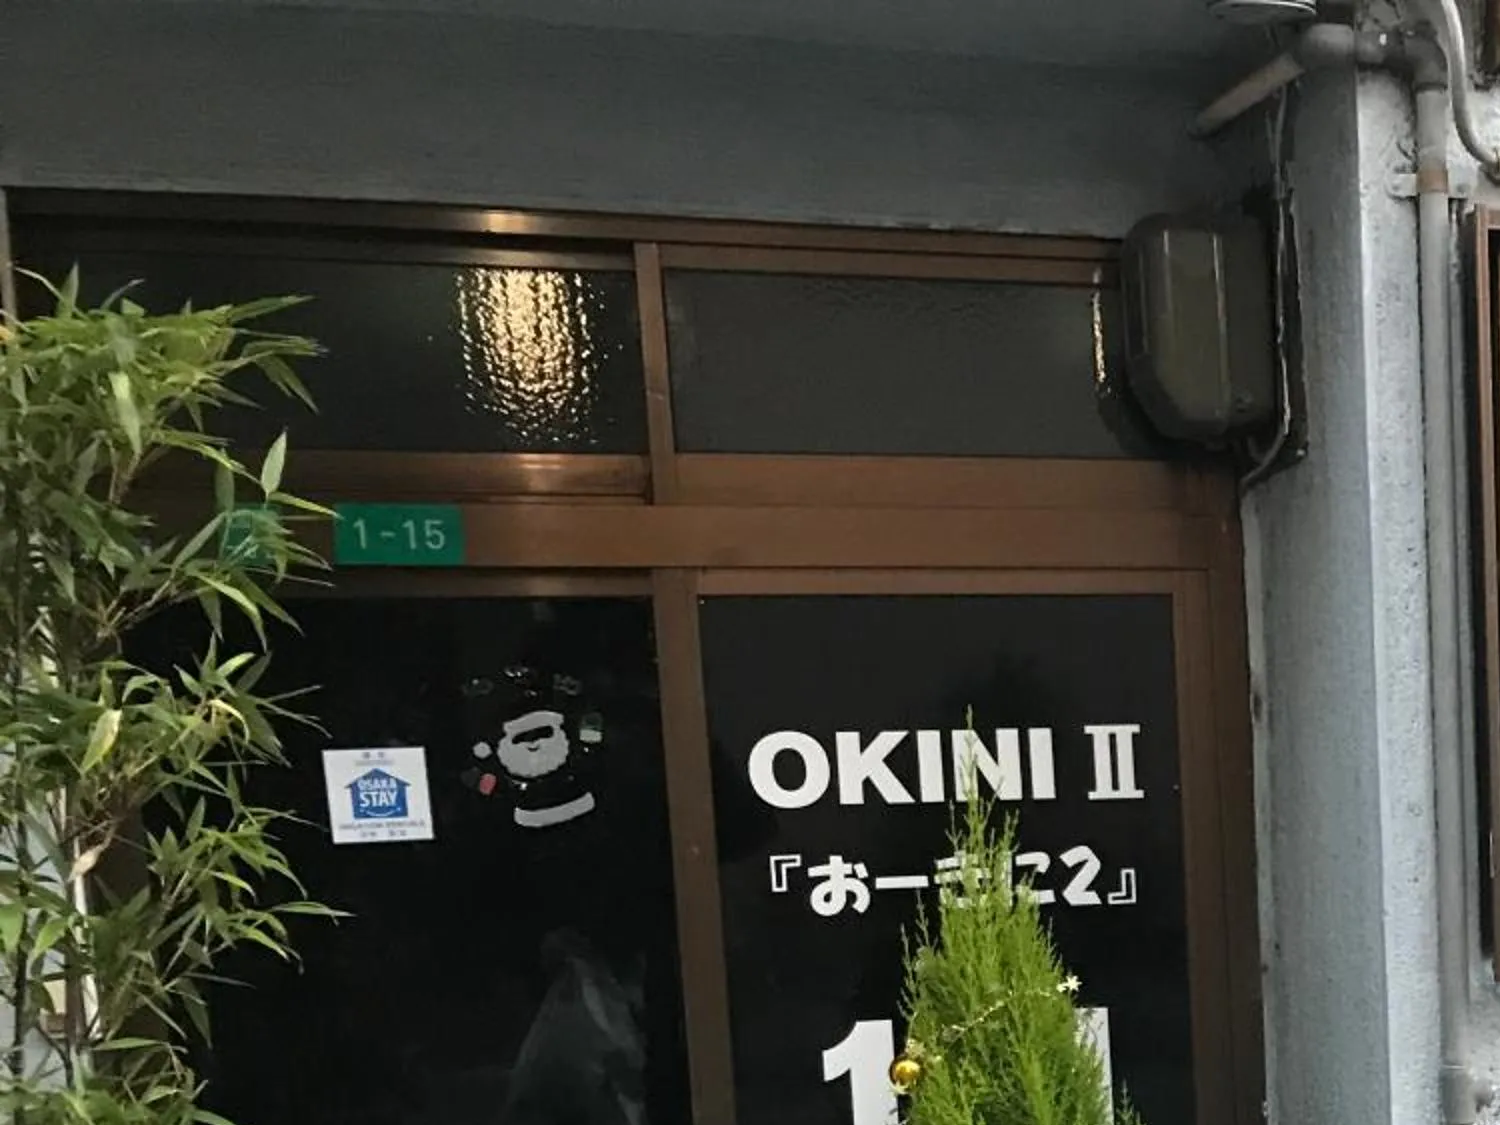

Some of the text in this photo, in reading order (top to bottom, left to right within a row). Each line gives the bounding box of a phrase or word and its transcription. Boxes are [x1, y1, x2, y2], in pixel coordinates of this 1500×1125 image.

[353, 519, 446, 551] 1-15
[748, 727, 1056, 809] OKINI
[359, 791, 398, 807] STAY
